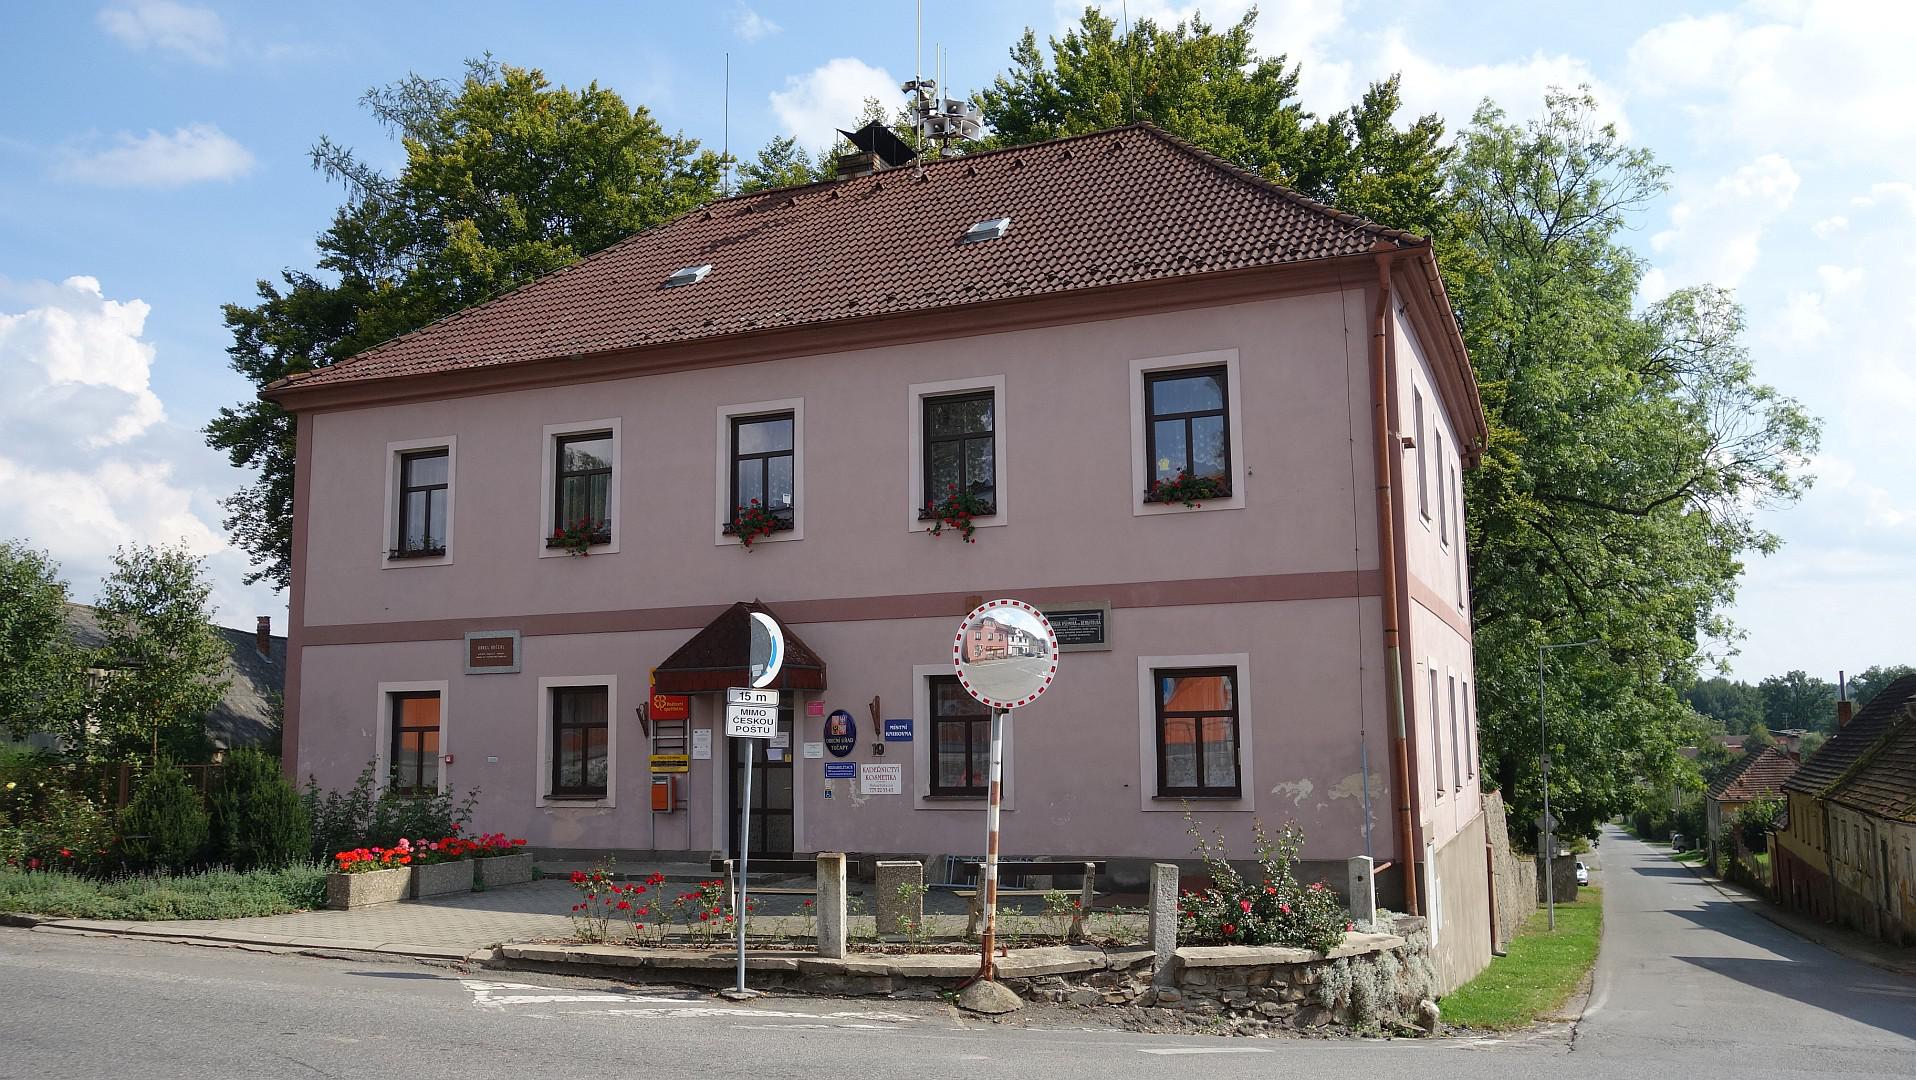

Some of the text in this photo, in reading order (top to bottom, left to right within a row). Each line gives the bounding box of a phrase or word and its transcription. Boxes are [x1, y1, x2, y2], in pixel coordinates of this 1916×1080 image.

[739, 692, 767, 702] 15 m
[740, 708, 767, 716] MIMO
[732, 715, 774, 725] ČESKOU
[735, 725, 770, 734] POŠTU
[871, 743, 885, 755] 19
